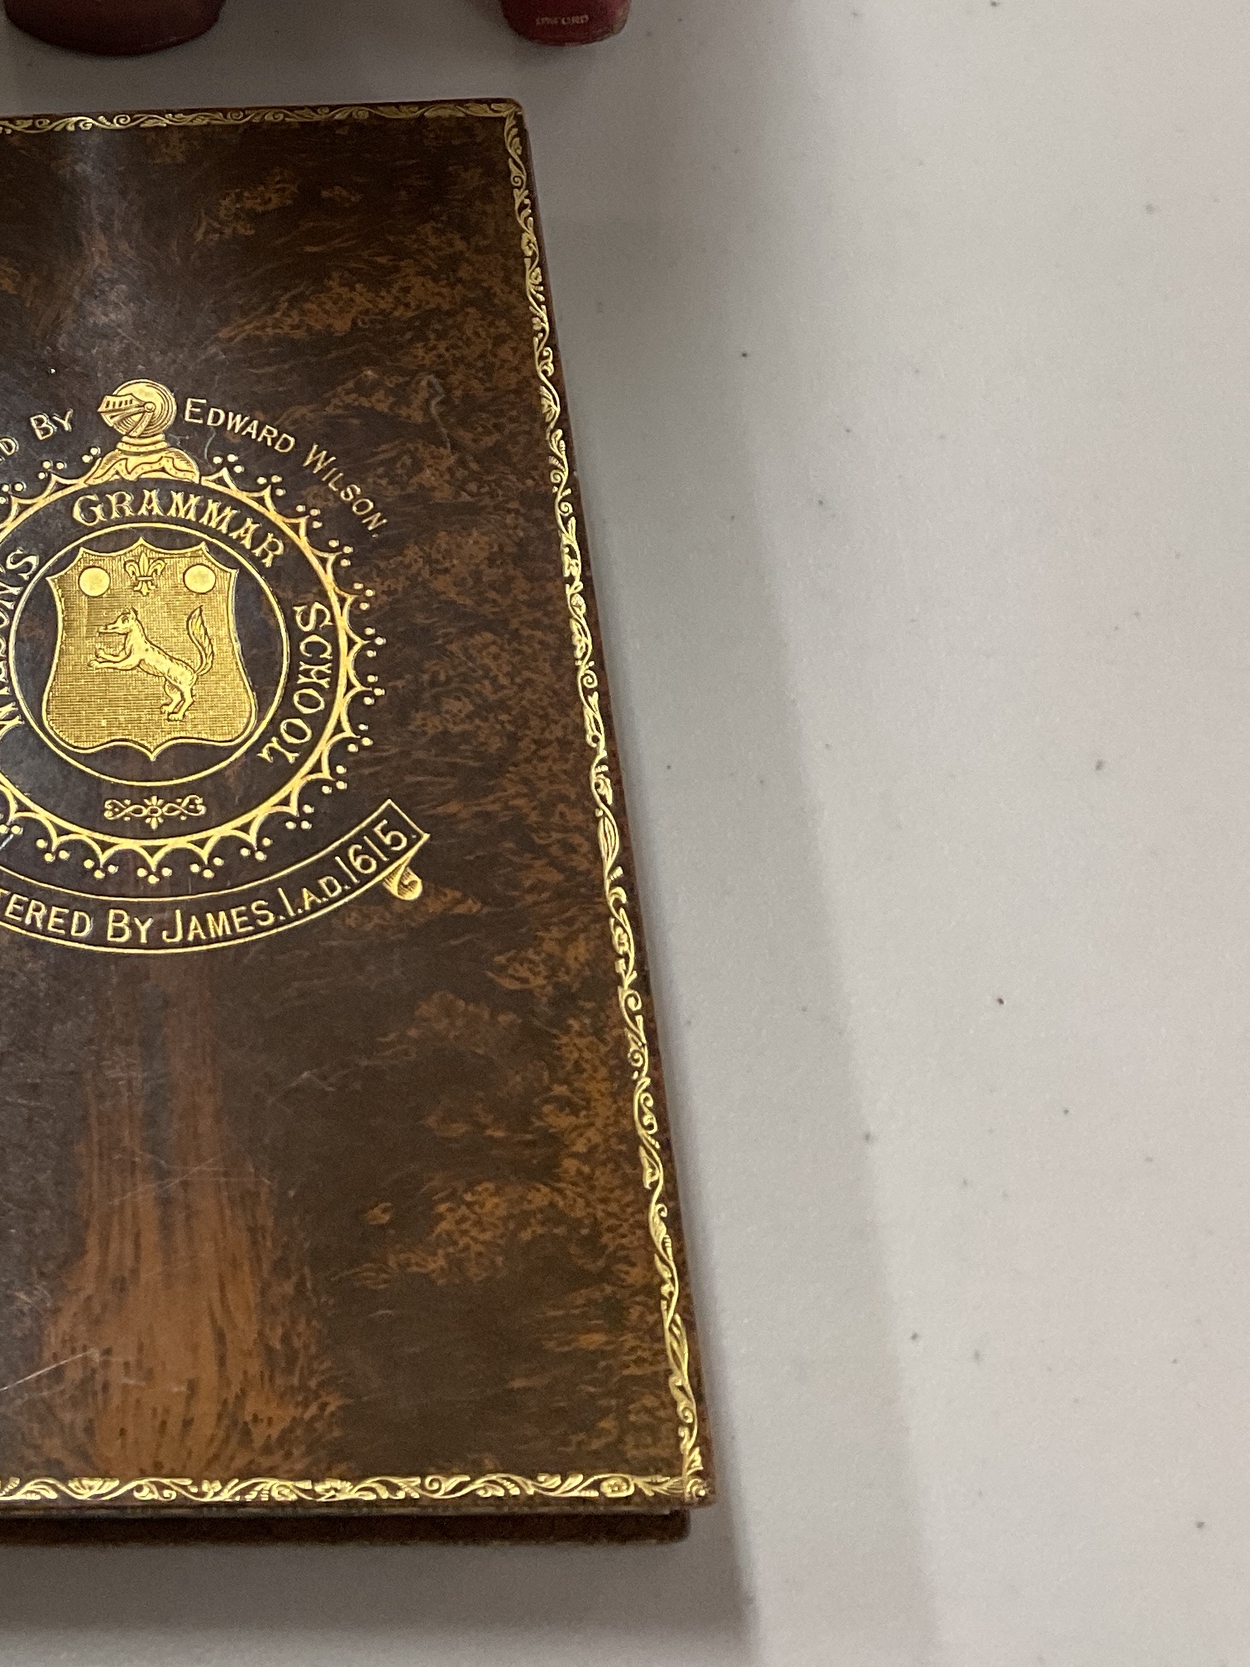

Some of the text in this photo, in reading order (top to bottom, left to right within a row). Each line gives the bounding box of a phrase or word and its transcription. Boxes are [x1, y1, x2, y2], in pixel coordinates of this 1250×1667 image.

[29, 408, 73, 441] BY
[184, 397, 295, 453] EDWARD
[72, 488, 284, 568] GRAMMAR
[257, 601, 333, 764] SCHOOL
[106, 909, 154, 944] BY
